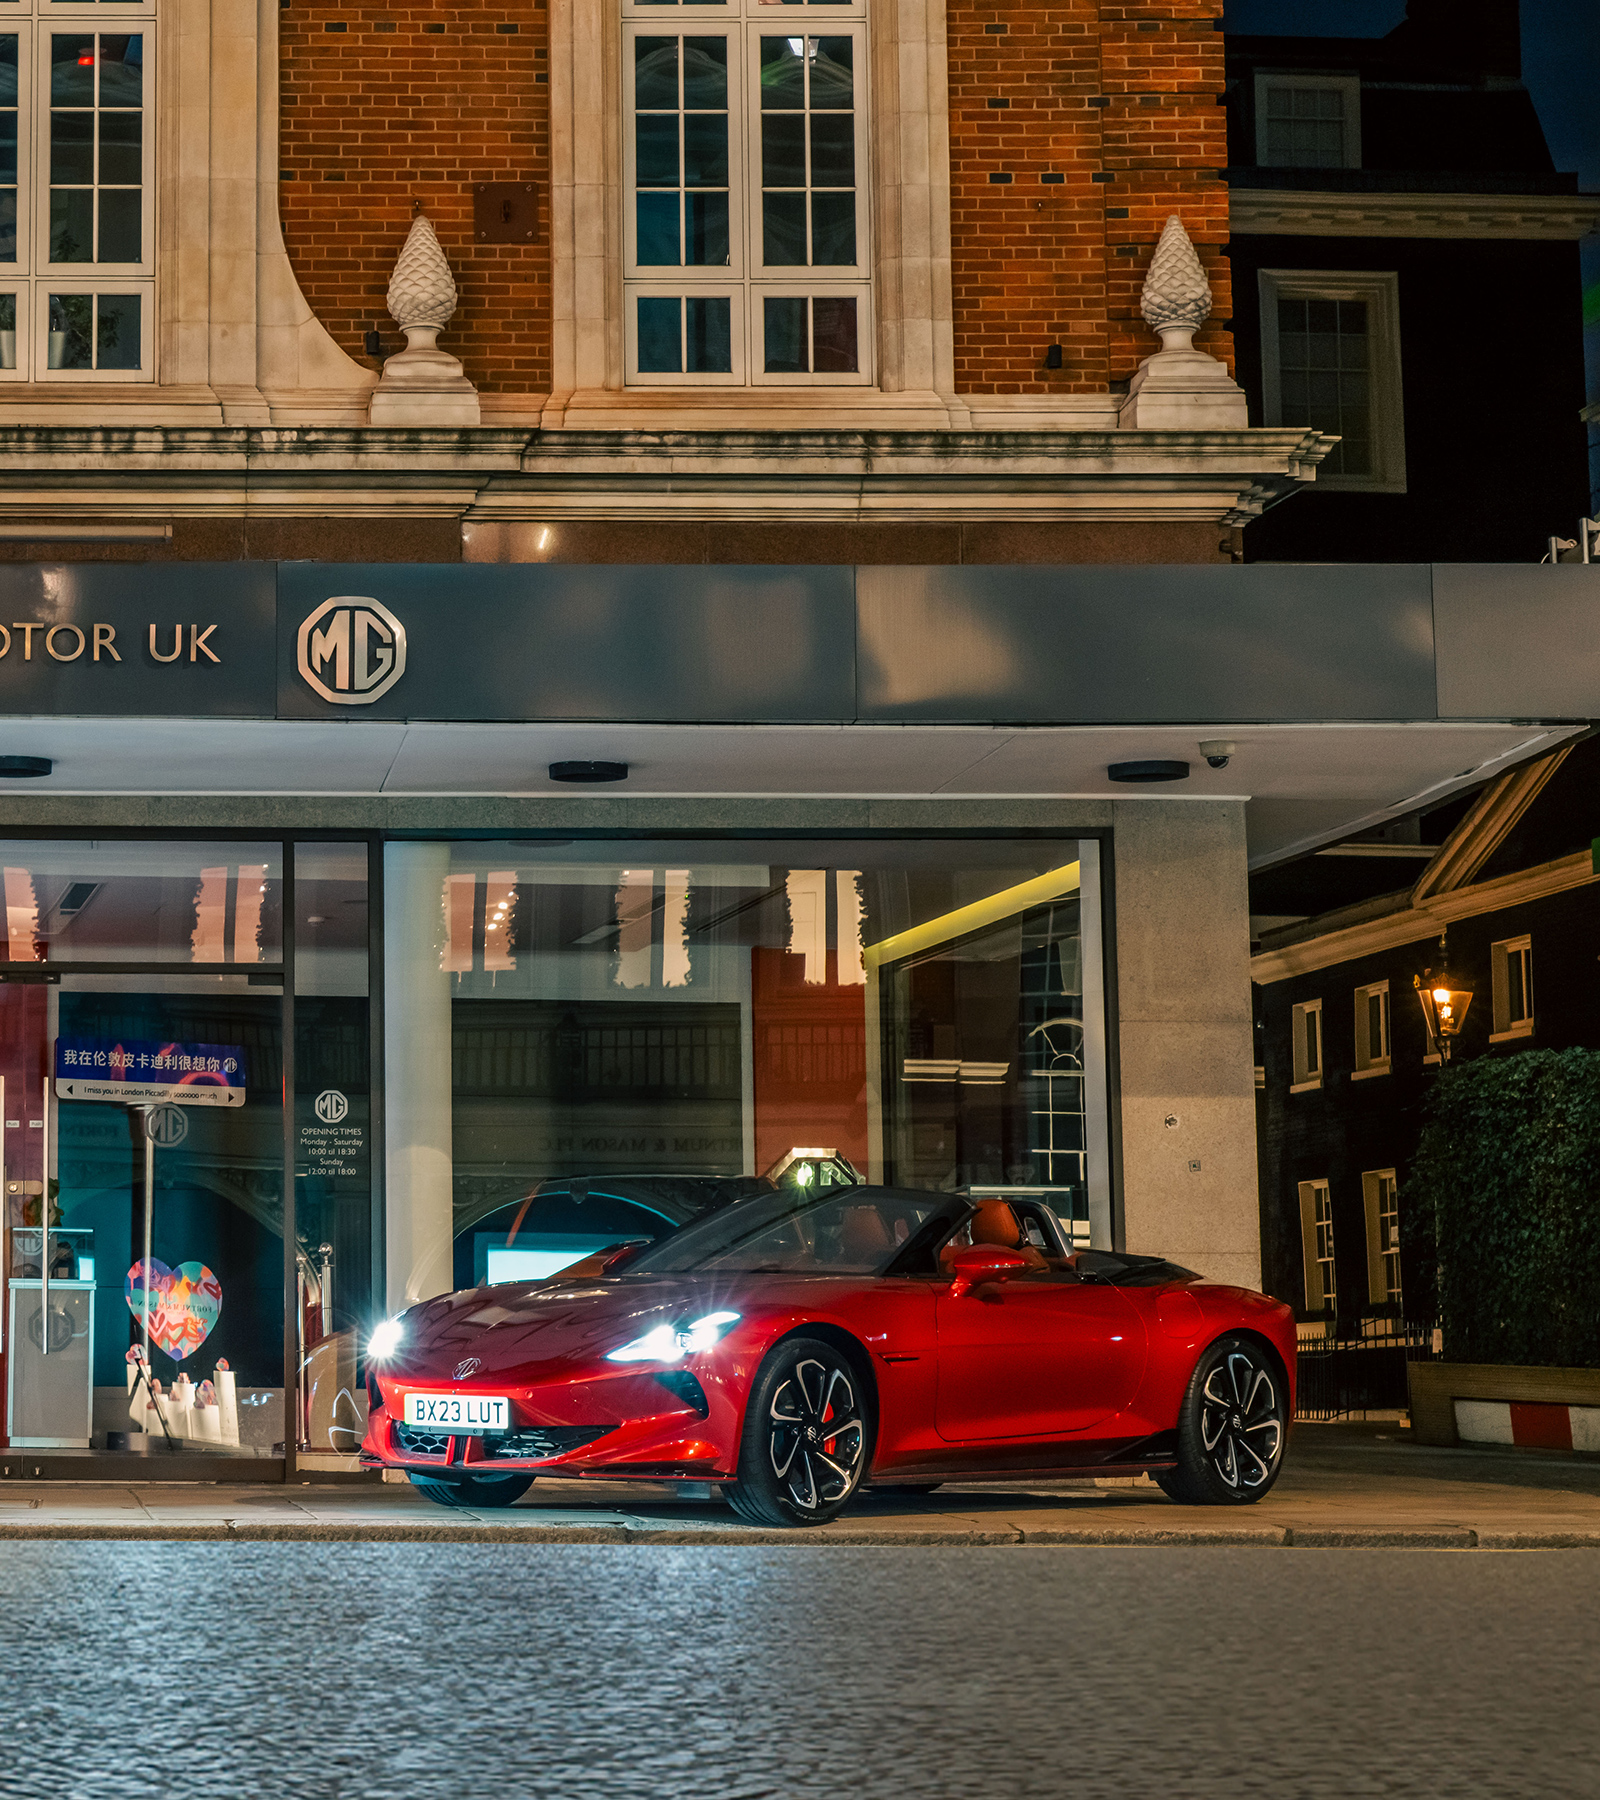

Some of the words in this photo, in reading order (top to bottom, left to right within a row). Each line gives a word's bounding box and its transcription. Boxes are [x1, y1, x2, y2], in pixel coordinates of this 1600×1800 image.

[148, 623, 222, 664] UK
[308, 606, 397, 693] MG
[64, 1049, 220, 1073] 我在伦敦皮卡迪利很想你
[87, 1086, 101, 1094] miss
[121, 1088, 144, 1096] London
[318, 1092, 345, 1121] MG
[150, 1107, 185, 1144] MG
[301, 1128, 339, 1136] OPENING
[339, 1128, 362, 1136] TIMES
[300, 1138, 327, 1146] Monday
[334, 1138, 363, 1147] Saturday
[320, 1157, 344, 1166] Sunday
[416, 1400, 461, 1423] BX23
[467, 1402, 503, 1424] LUT
